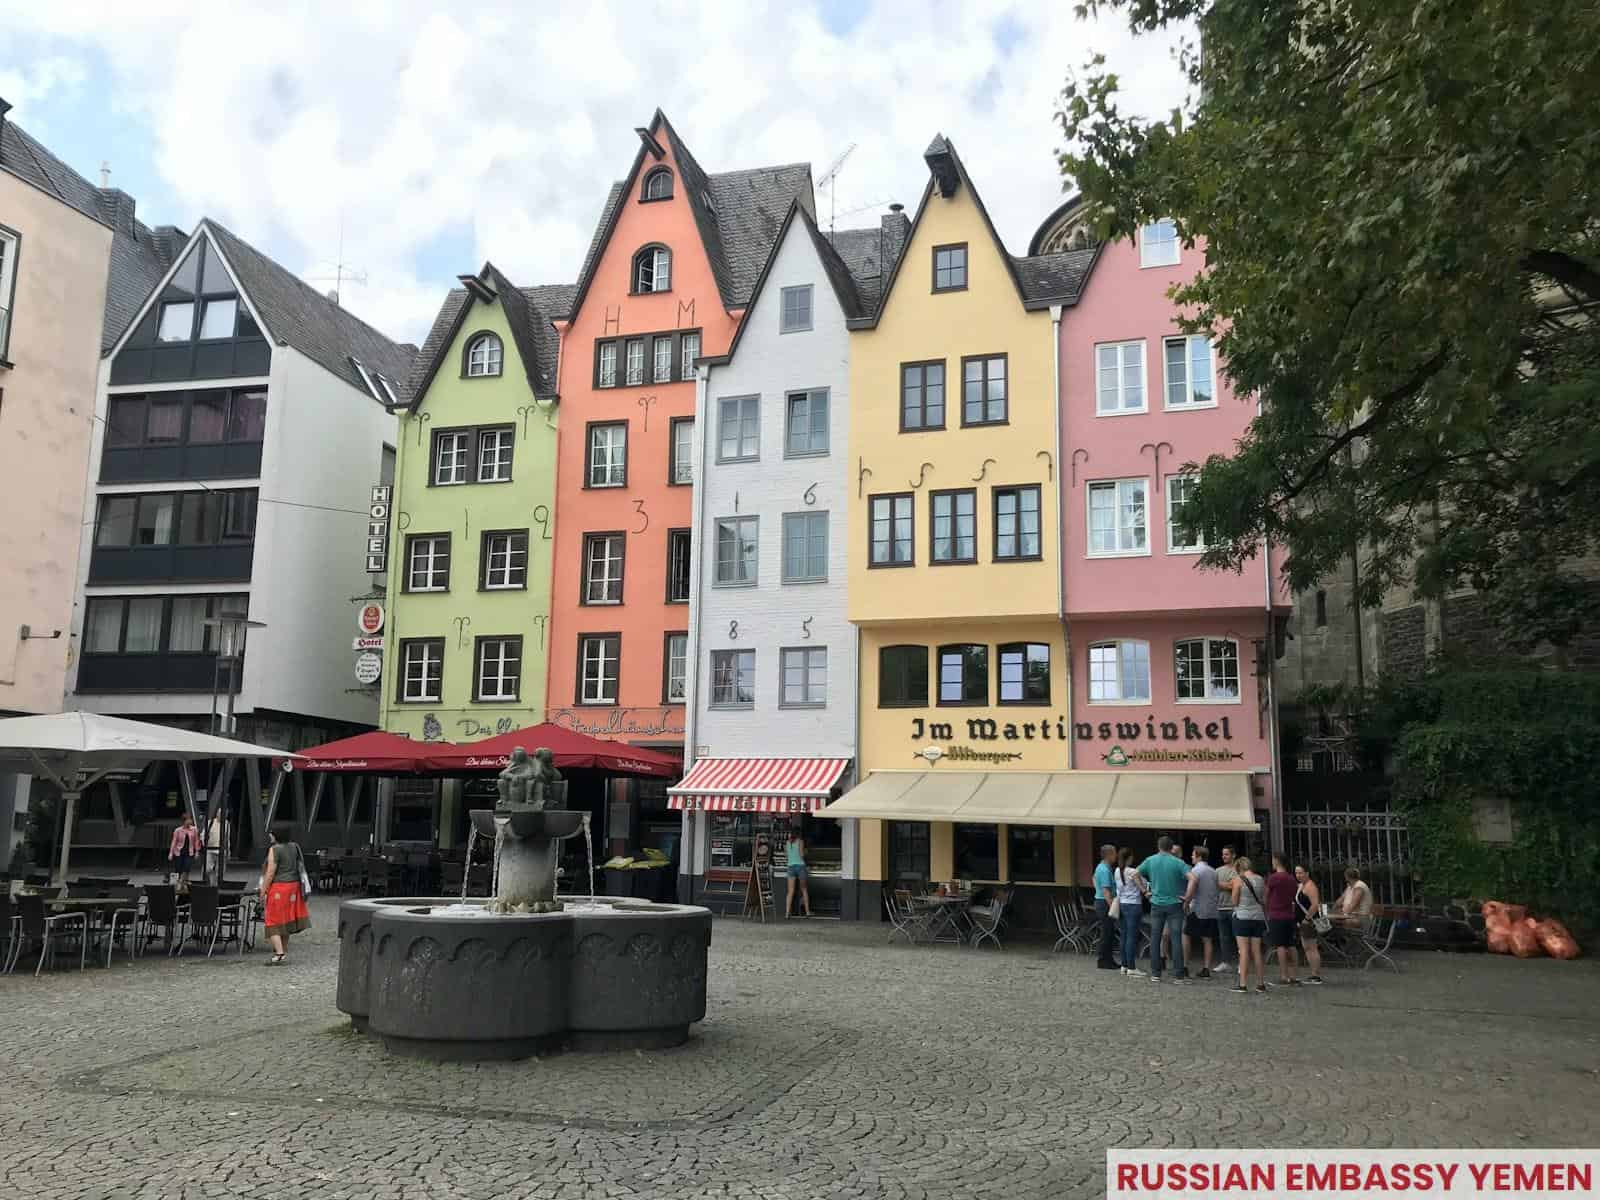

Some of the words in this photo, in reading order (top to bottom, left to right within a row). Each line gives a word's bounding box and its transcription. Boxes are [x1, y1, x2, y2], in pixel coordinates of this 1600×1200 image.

[803, 482, 817, 505] 6
[368, 488, 388, 570] HOTEL
[631, 500, 648, 535] 3
[729, 620, 738, 640] 8
[801, 617, 812, 638] 5
[456, 719, 492, 737] Das
[911, 718, 953, 741] Im
[966, 715, 1234, 741] Martinswinkel
